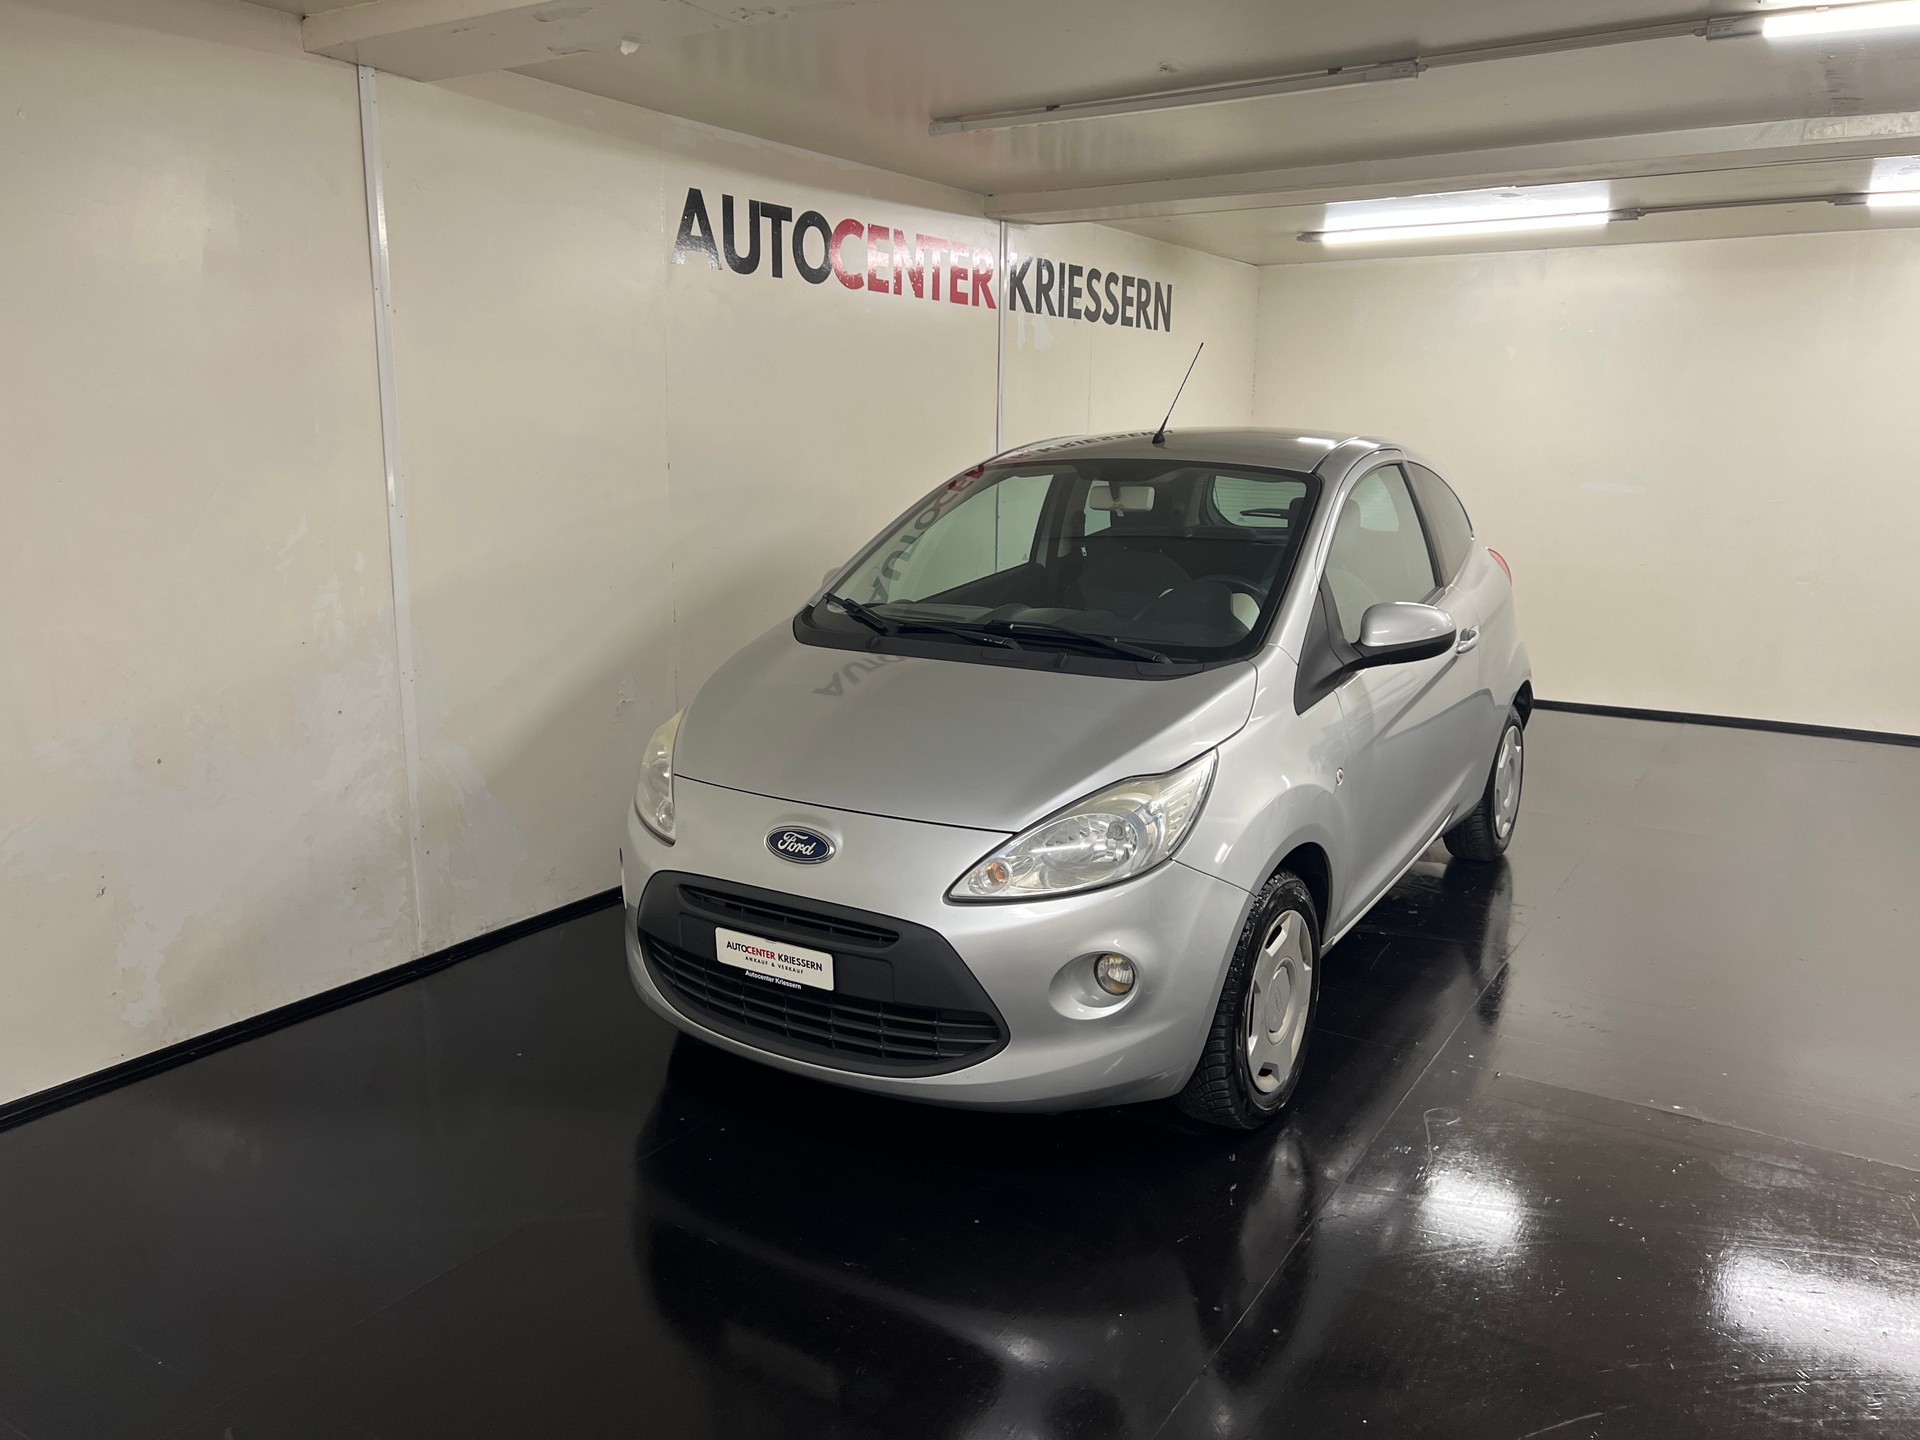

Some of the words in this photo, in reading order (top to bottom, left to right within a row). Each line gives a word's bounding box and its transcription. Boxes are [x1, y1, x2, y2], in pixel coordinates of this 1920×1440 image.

[670, 187, 997, 310] AUTOCENTER
[1009, 252, 1173, 332] KRIESSERN
[778, 832, 816, 855] Ford
[726, 941, 776, 960] AUTOCENTER
[778, 953, 822, 971] KRIESSERN
[745, 956, 768, 966] ANKAUF
[778, 964, 804, 974] VERKAUF
[745, 970, 774, 983] Autocenter
[775, 977, 802, 989] Kriessern
